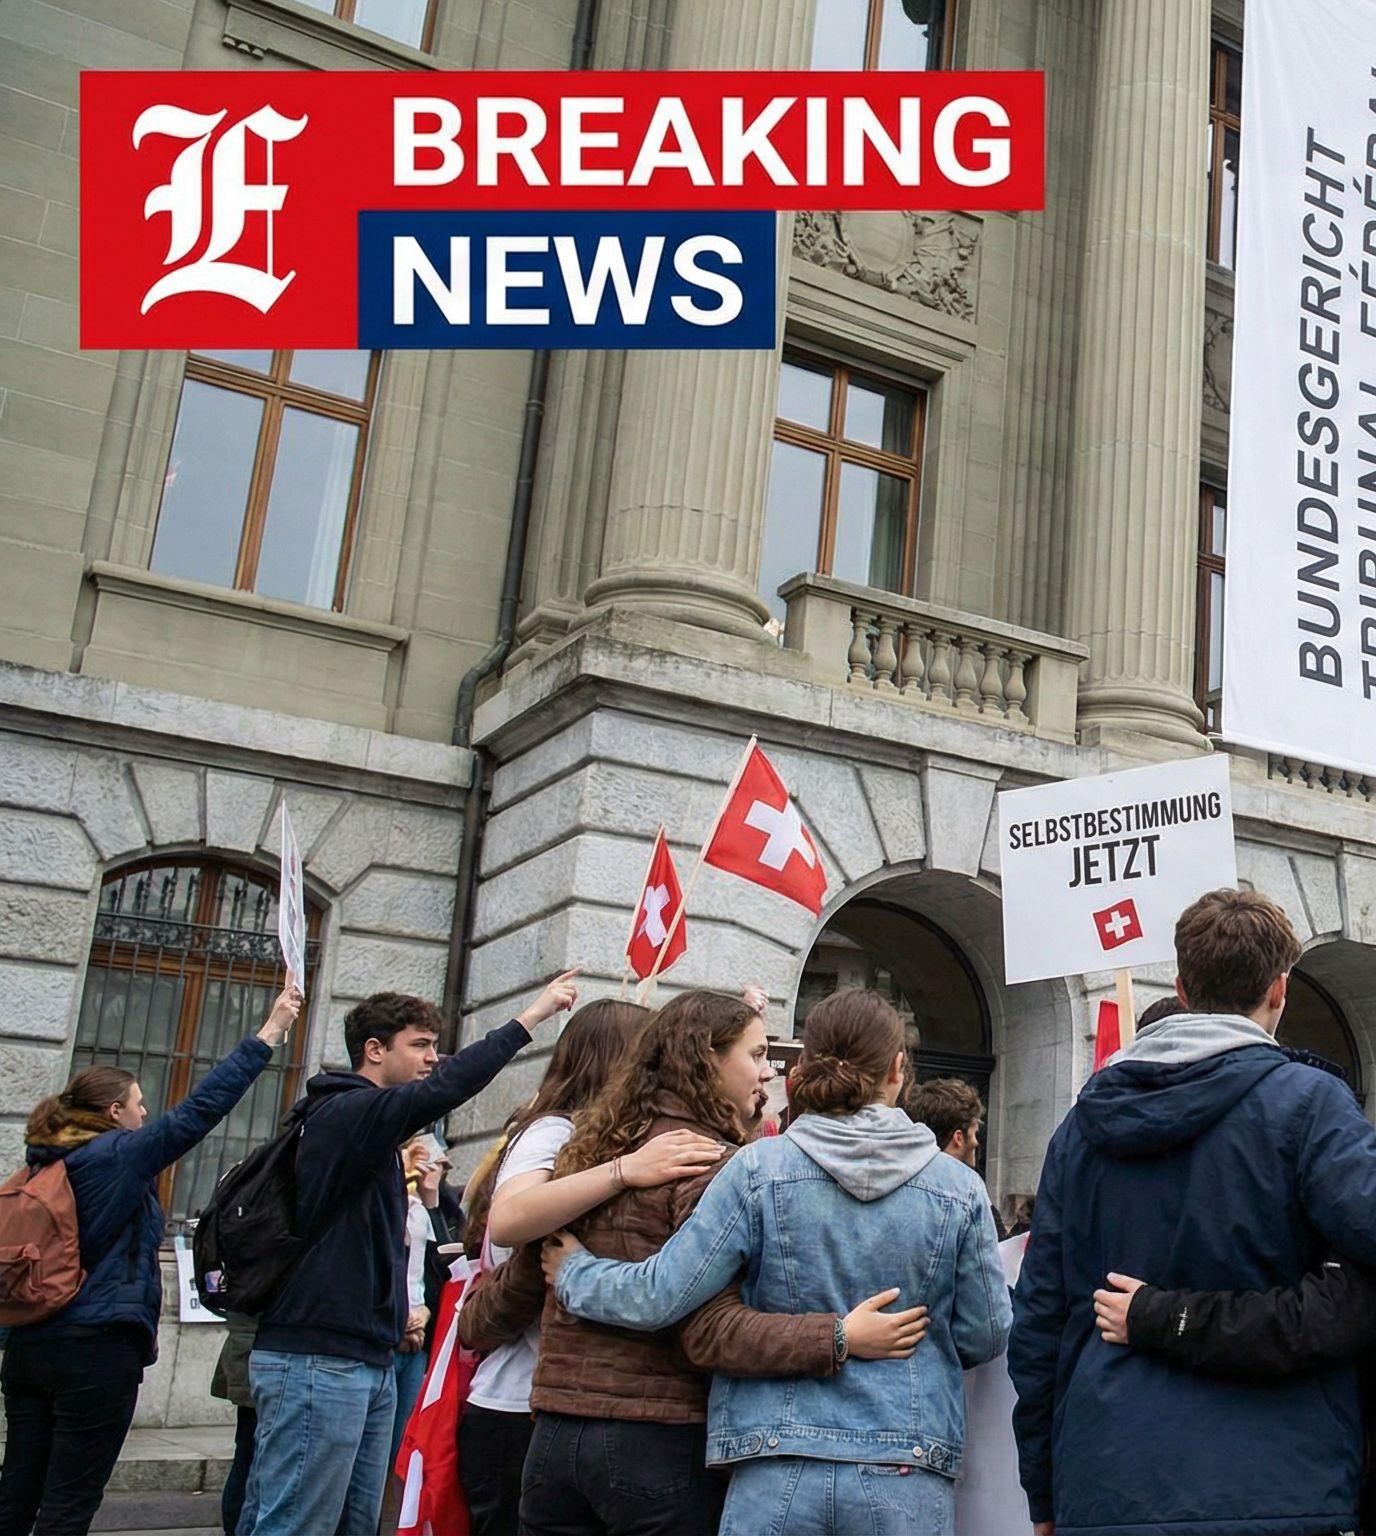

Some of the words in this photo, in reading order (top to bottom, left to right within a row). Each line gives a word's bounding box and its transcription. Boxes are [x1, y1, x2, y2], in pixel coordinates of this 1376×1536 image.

[1296, 126, 1345, 688] BUNDESGERICHT
[1009, 792, 1222, 850] SELBSTBESTIMMUNG
[1069, 834, 1160, 888] JETZT
